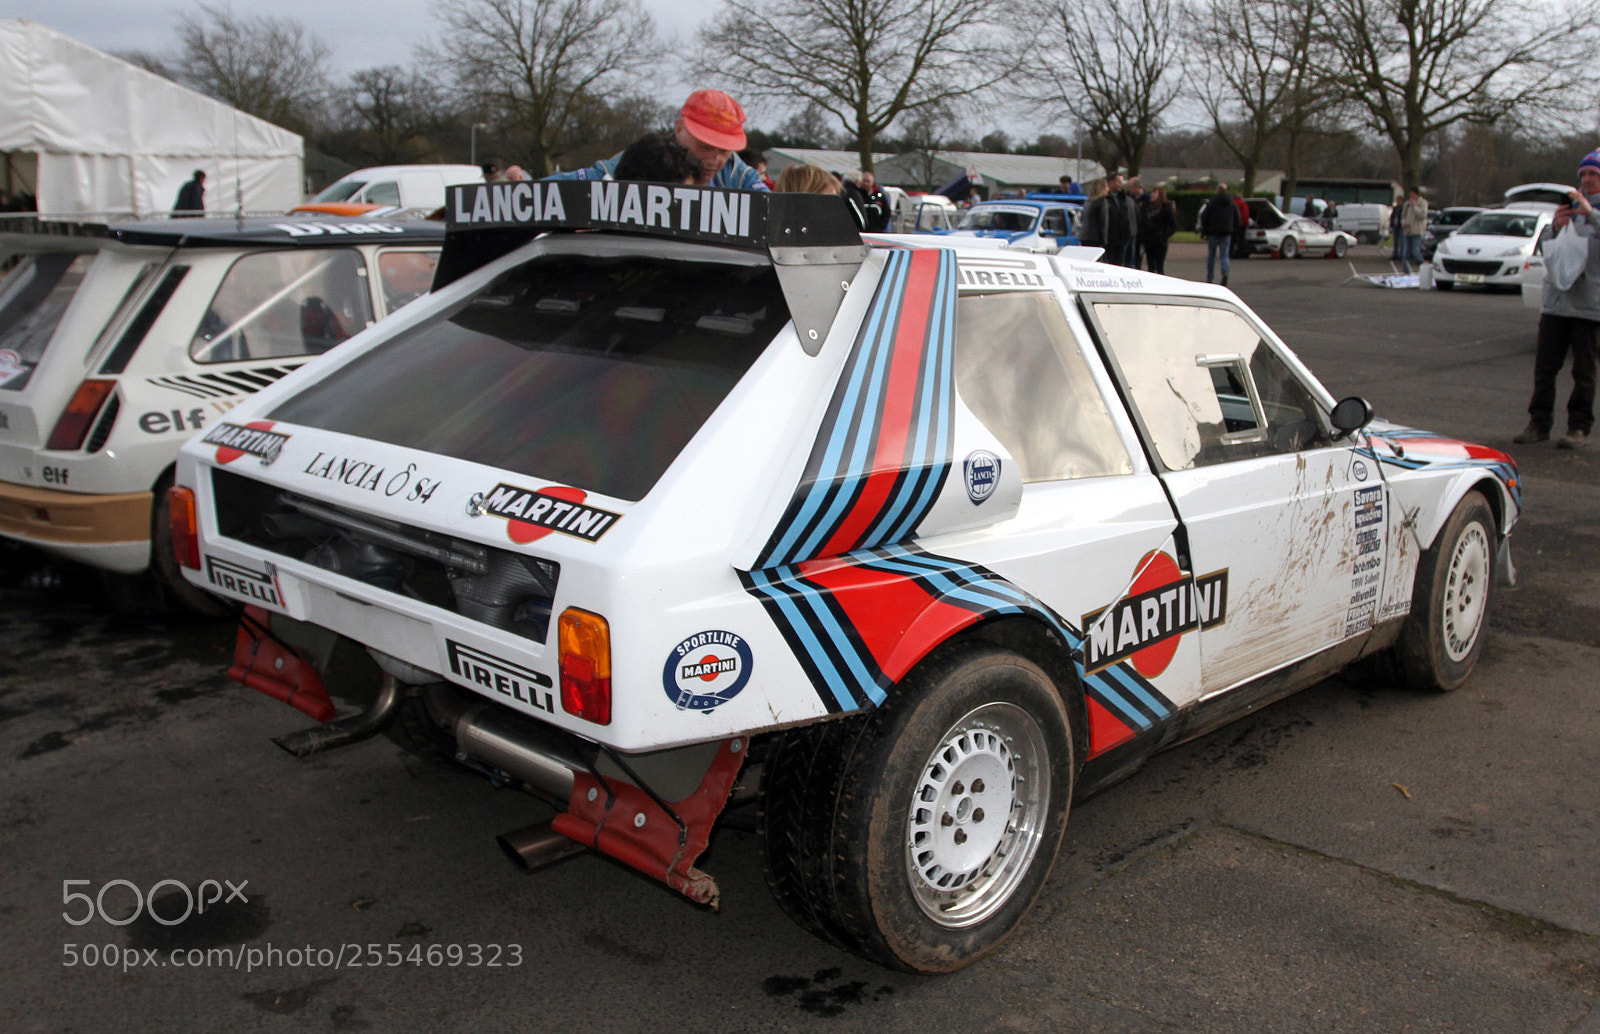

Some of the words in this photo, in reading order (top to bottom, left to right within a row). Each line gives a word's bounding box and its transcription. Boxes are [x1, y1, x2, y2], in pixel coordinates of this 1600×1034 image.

[455, 182, 566, 223] LANCIA
[591, 181, 750, 237] MARTINI
[139, 408, 205, 434] elf
[207, 424, 285, 458] MARTINI
[42, 465, 70, 485] elf
[304, 452, 386, 491] LANCIA
[407, 477, 443, 504] S4
[973, 470, 993, 481] LANCIA
[1355, 489, 1382, 506] Savara
[487, 486, 614, 542] MARTINI
[1353, 556, 1381, 575] brembo
[205, 554, 278, 605] PIRELLI
[1351, 584, 1378, 605] olivetti
[1089, 580, 1222, 664] MARTINI
[677, 632, 741, 656] SPORTLINE
[445, 638, 555, 715] PIRELLI
[684, 660, 735, 678] MARTINI
